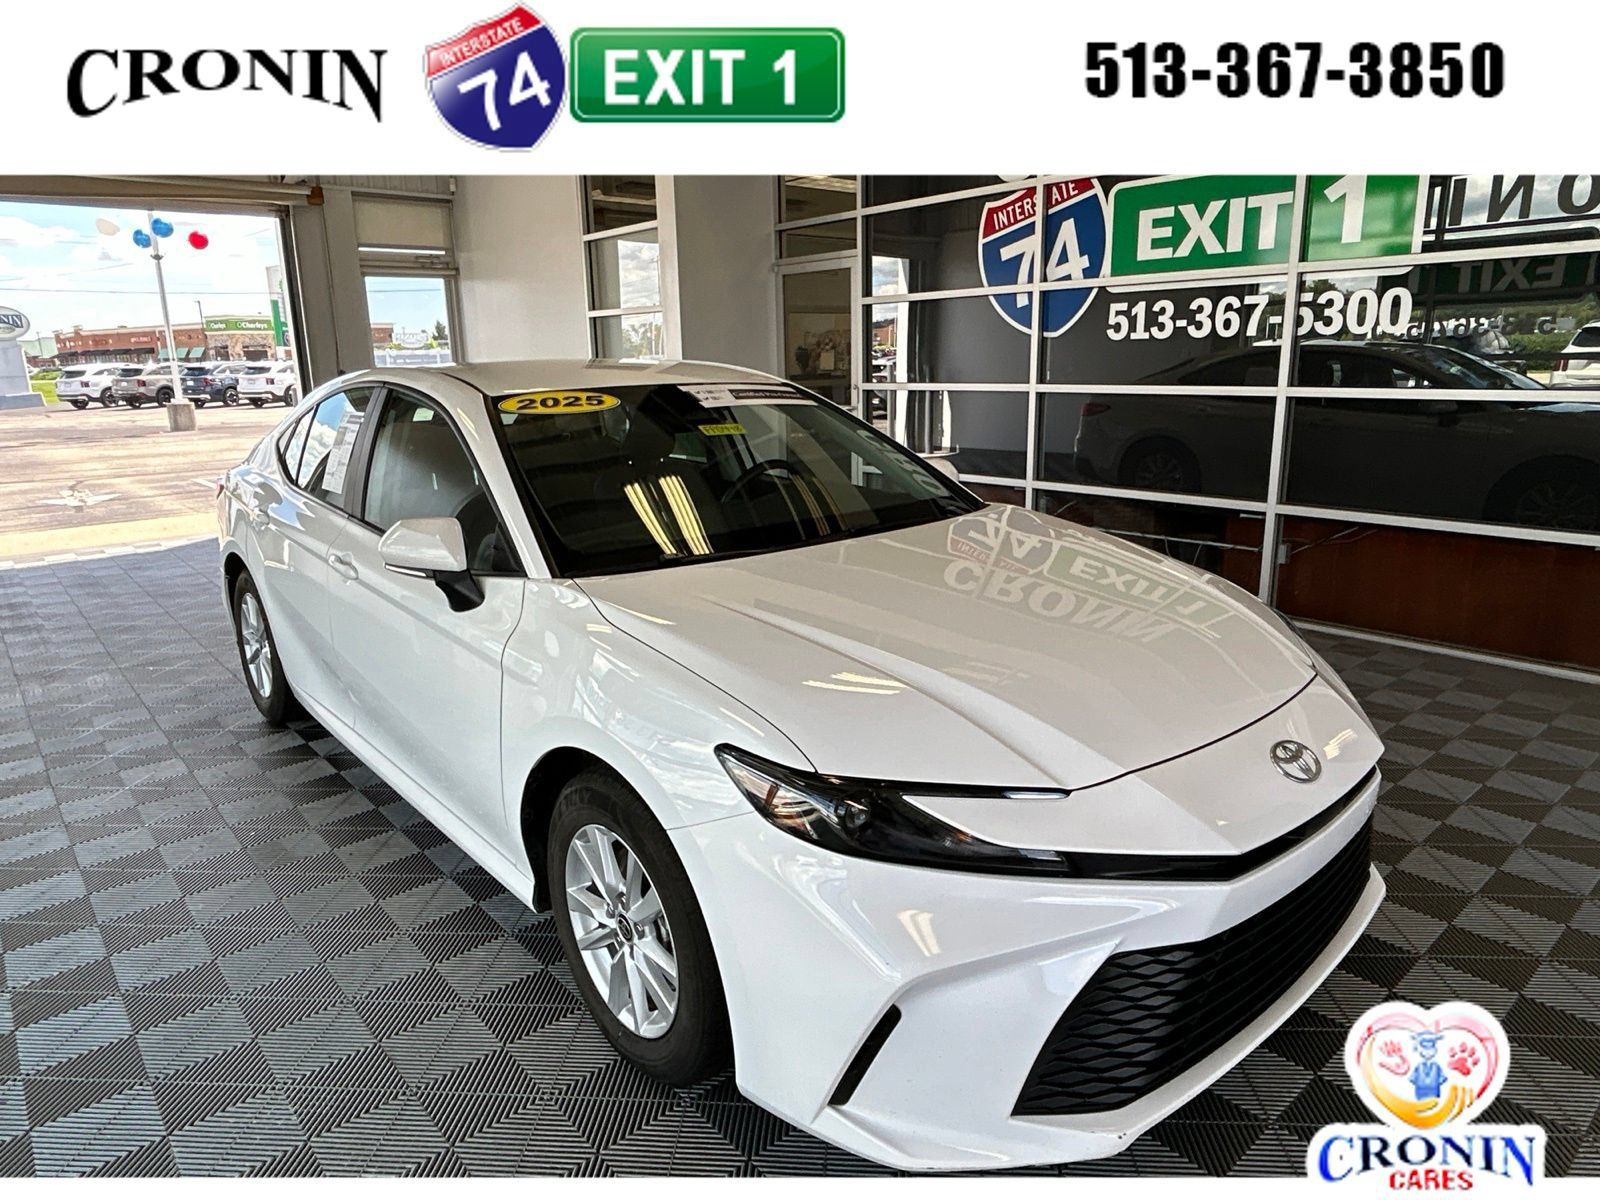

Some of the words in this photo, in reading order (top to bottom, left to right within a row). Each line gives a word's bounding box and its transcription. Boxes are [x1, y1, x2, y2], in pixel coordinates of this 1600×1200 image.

[993, 181, 1079, 231] INTERATE
[1136, 190, 1295, 262] EXIT
[1323, 175, 1368, 244] 1
[1000, 217, 1090, 309] 74
[1106, 286, 1413, 342] 513-367-5300
[516, 395, 606, 411] 2025
